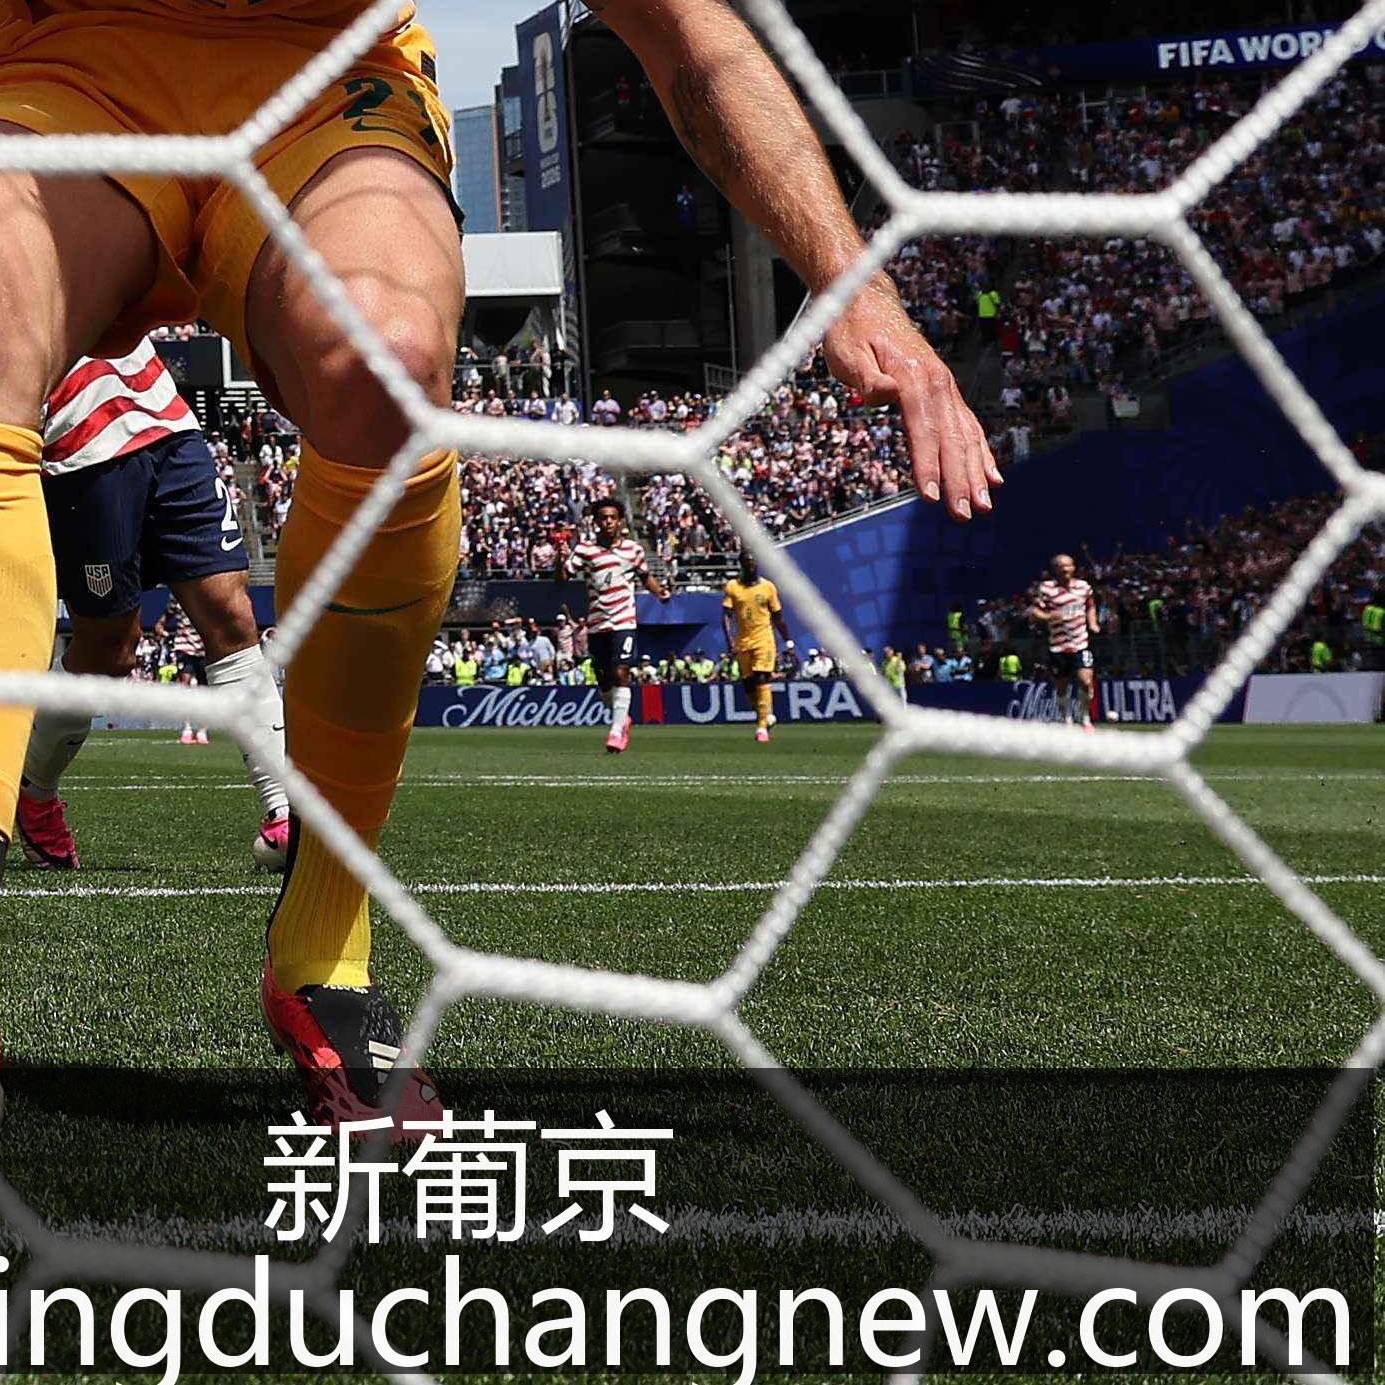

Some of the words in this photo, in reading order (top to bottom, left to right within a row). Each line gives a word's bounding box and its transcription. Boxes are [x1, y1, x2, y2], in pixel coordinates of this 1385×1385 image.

[1157, 38, 1235, 69] FIFA
[1237, 28, 1369, 62] WOR
[215, 477, 239, 532] 2
[86, 566, 109, 579] USA
[1101, 678, 1177, 722] ULTRA
